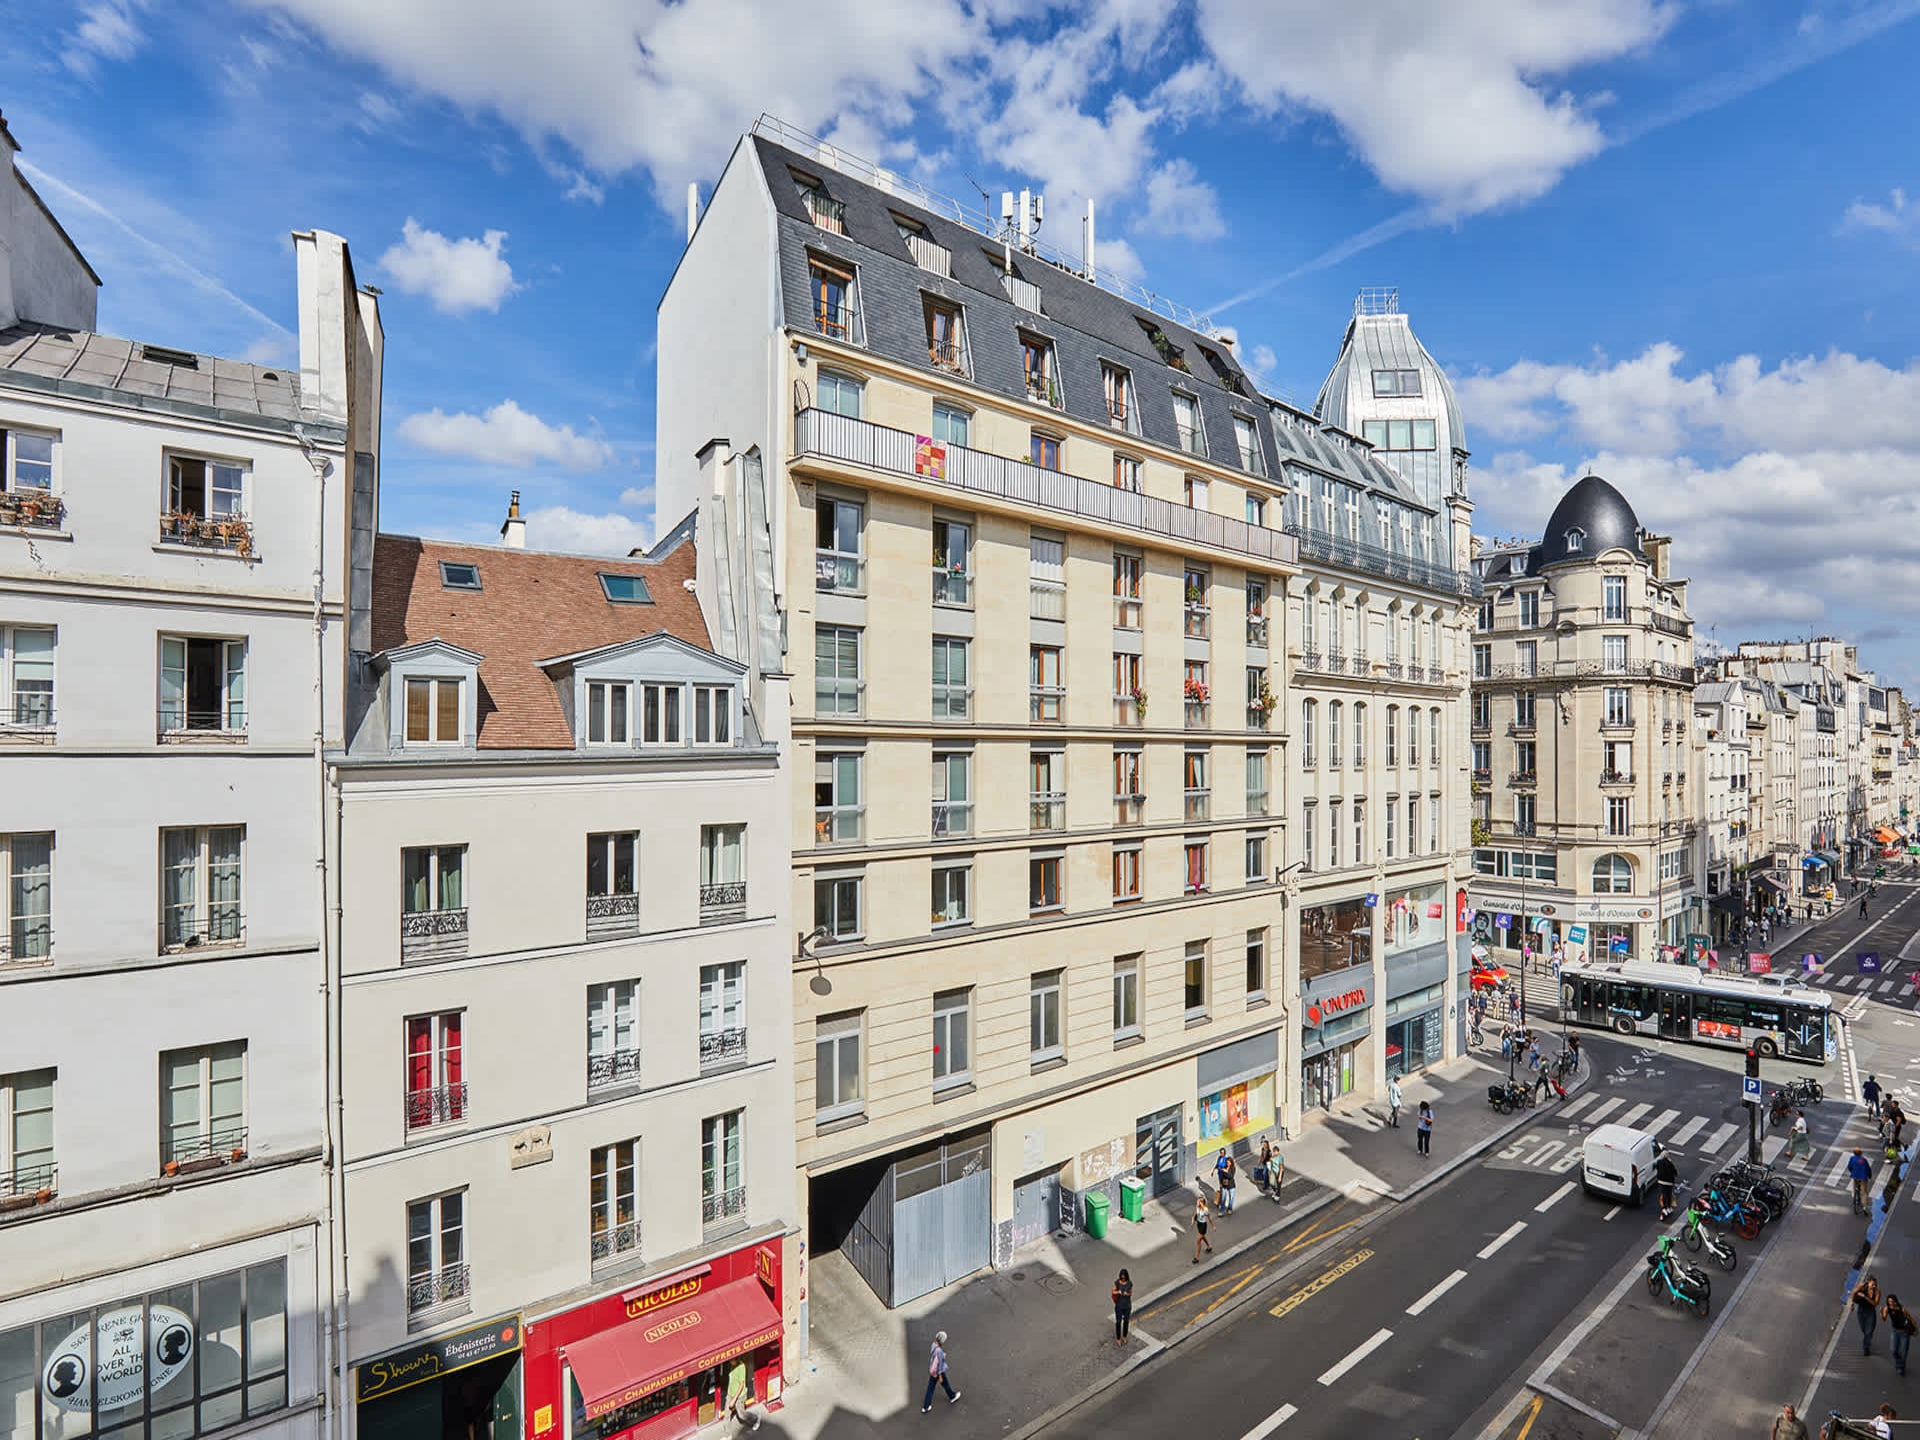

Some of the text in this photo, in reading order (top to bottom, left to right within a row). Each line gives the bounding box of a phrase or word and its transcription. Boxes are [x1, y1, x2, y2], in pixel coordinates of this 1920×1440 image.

[1748, 1081, 1756, 1091] P
[1497, 1135, 1584, 1174] BUS
[762, 1254, 770, 1277] N
[1277, 1249, 1373, 1315] LIVRAISONS
[632, 1278, 697, 1313] NICOLAS
[647, 1314, 698, 1340] NICOLAS
[112, 1345, 131, 1357] ALL
[445, 1334, 496, 1357] Ébénisterie
[698, 1329, 780, 1369] COFFRETS CADEAUX
[130, 1353, 144, 1363] TH
[101, 1365, 143, 1383] WORLD
[593, 1400, 616, 1414] VINS
[624, 1369, 684, 1401] CHAMPAGNES
